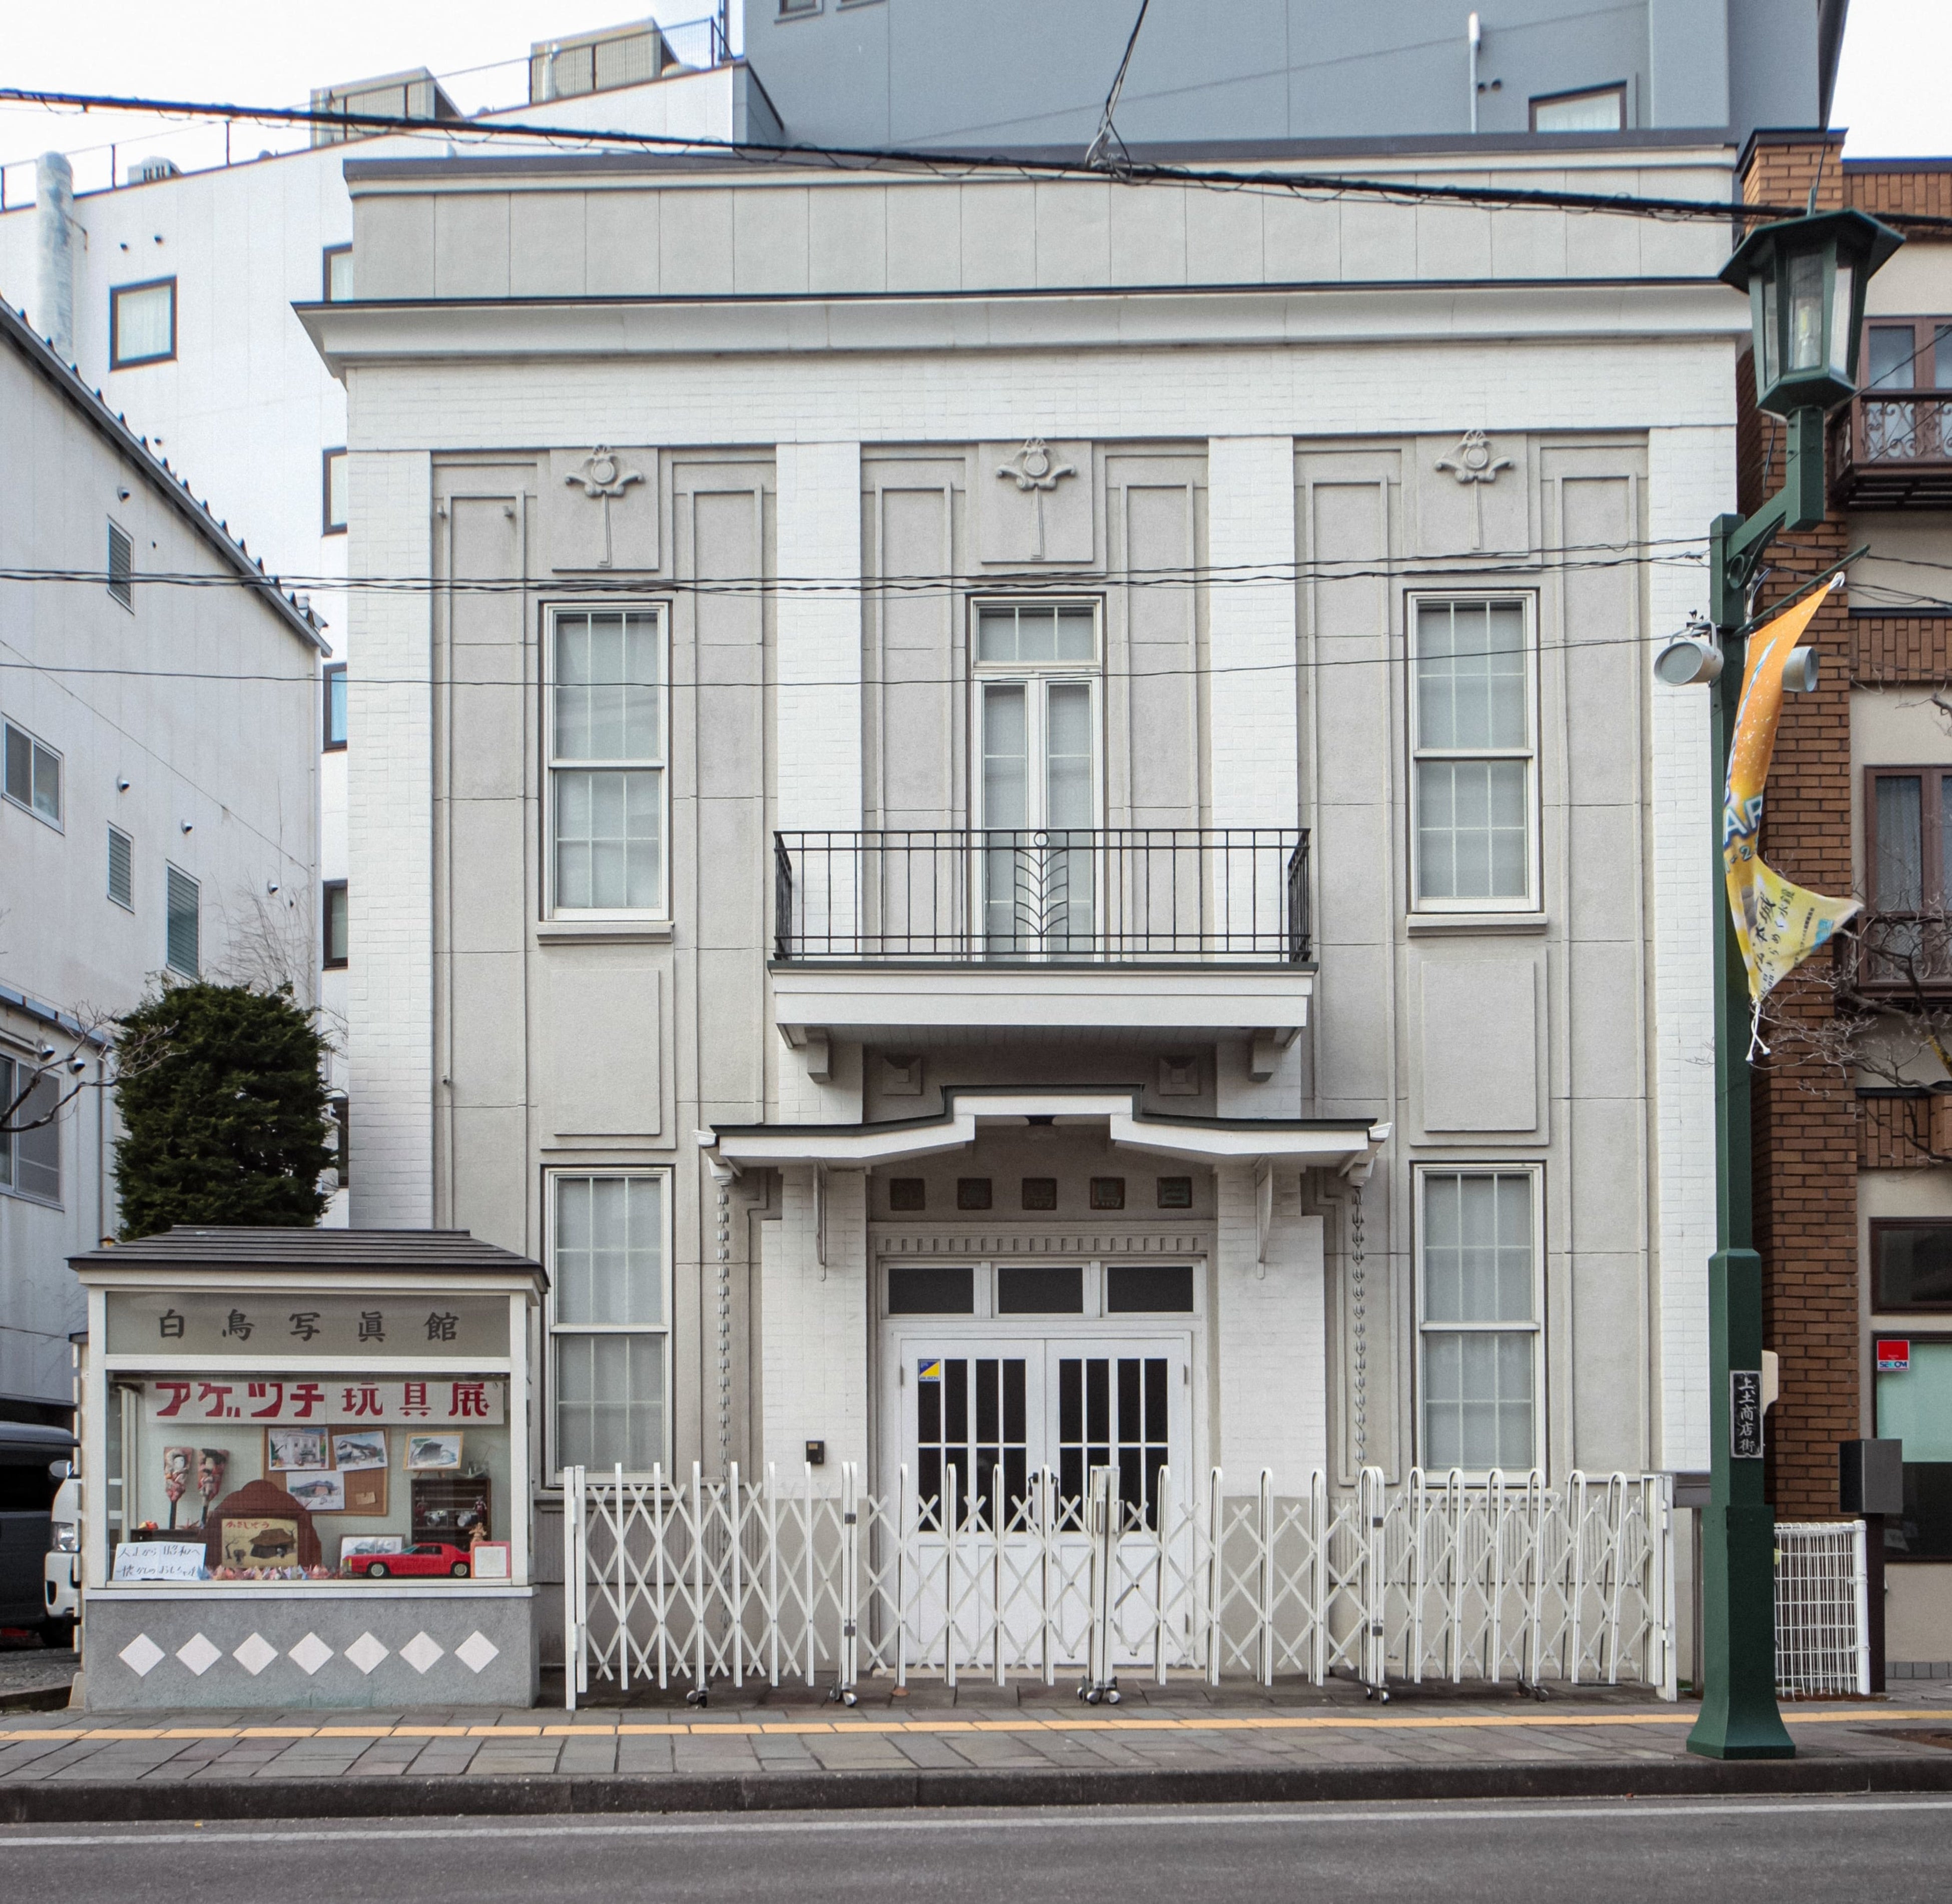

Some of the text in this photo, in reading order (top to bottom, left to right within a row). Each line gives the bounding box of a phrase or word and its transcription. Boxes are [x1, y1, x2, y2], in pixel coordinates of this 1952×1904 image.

[159, 1309, 459, 1342] 白鳥写眞館
[1738, 1376, 1757, 1453] 上土商店街
